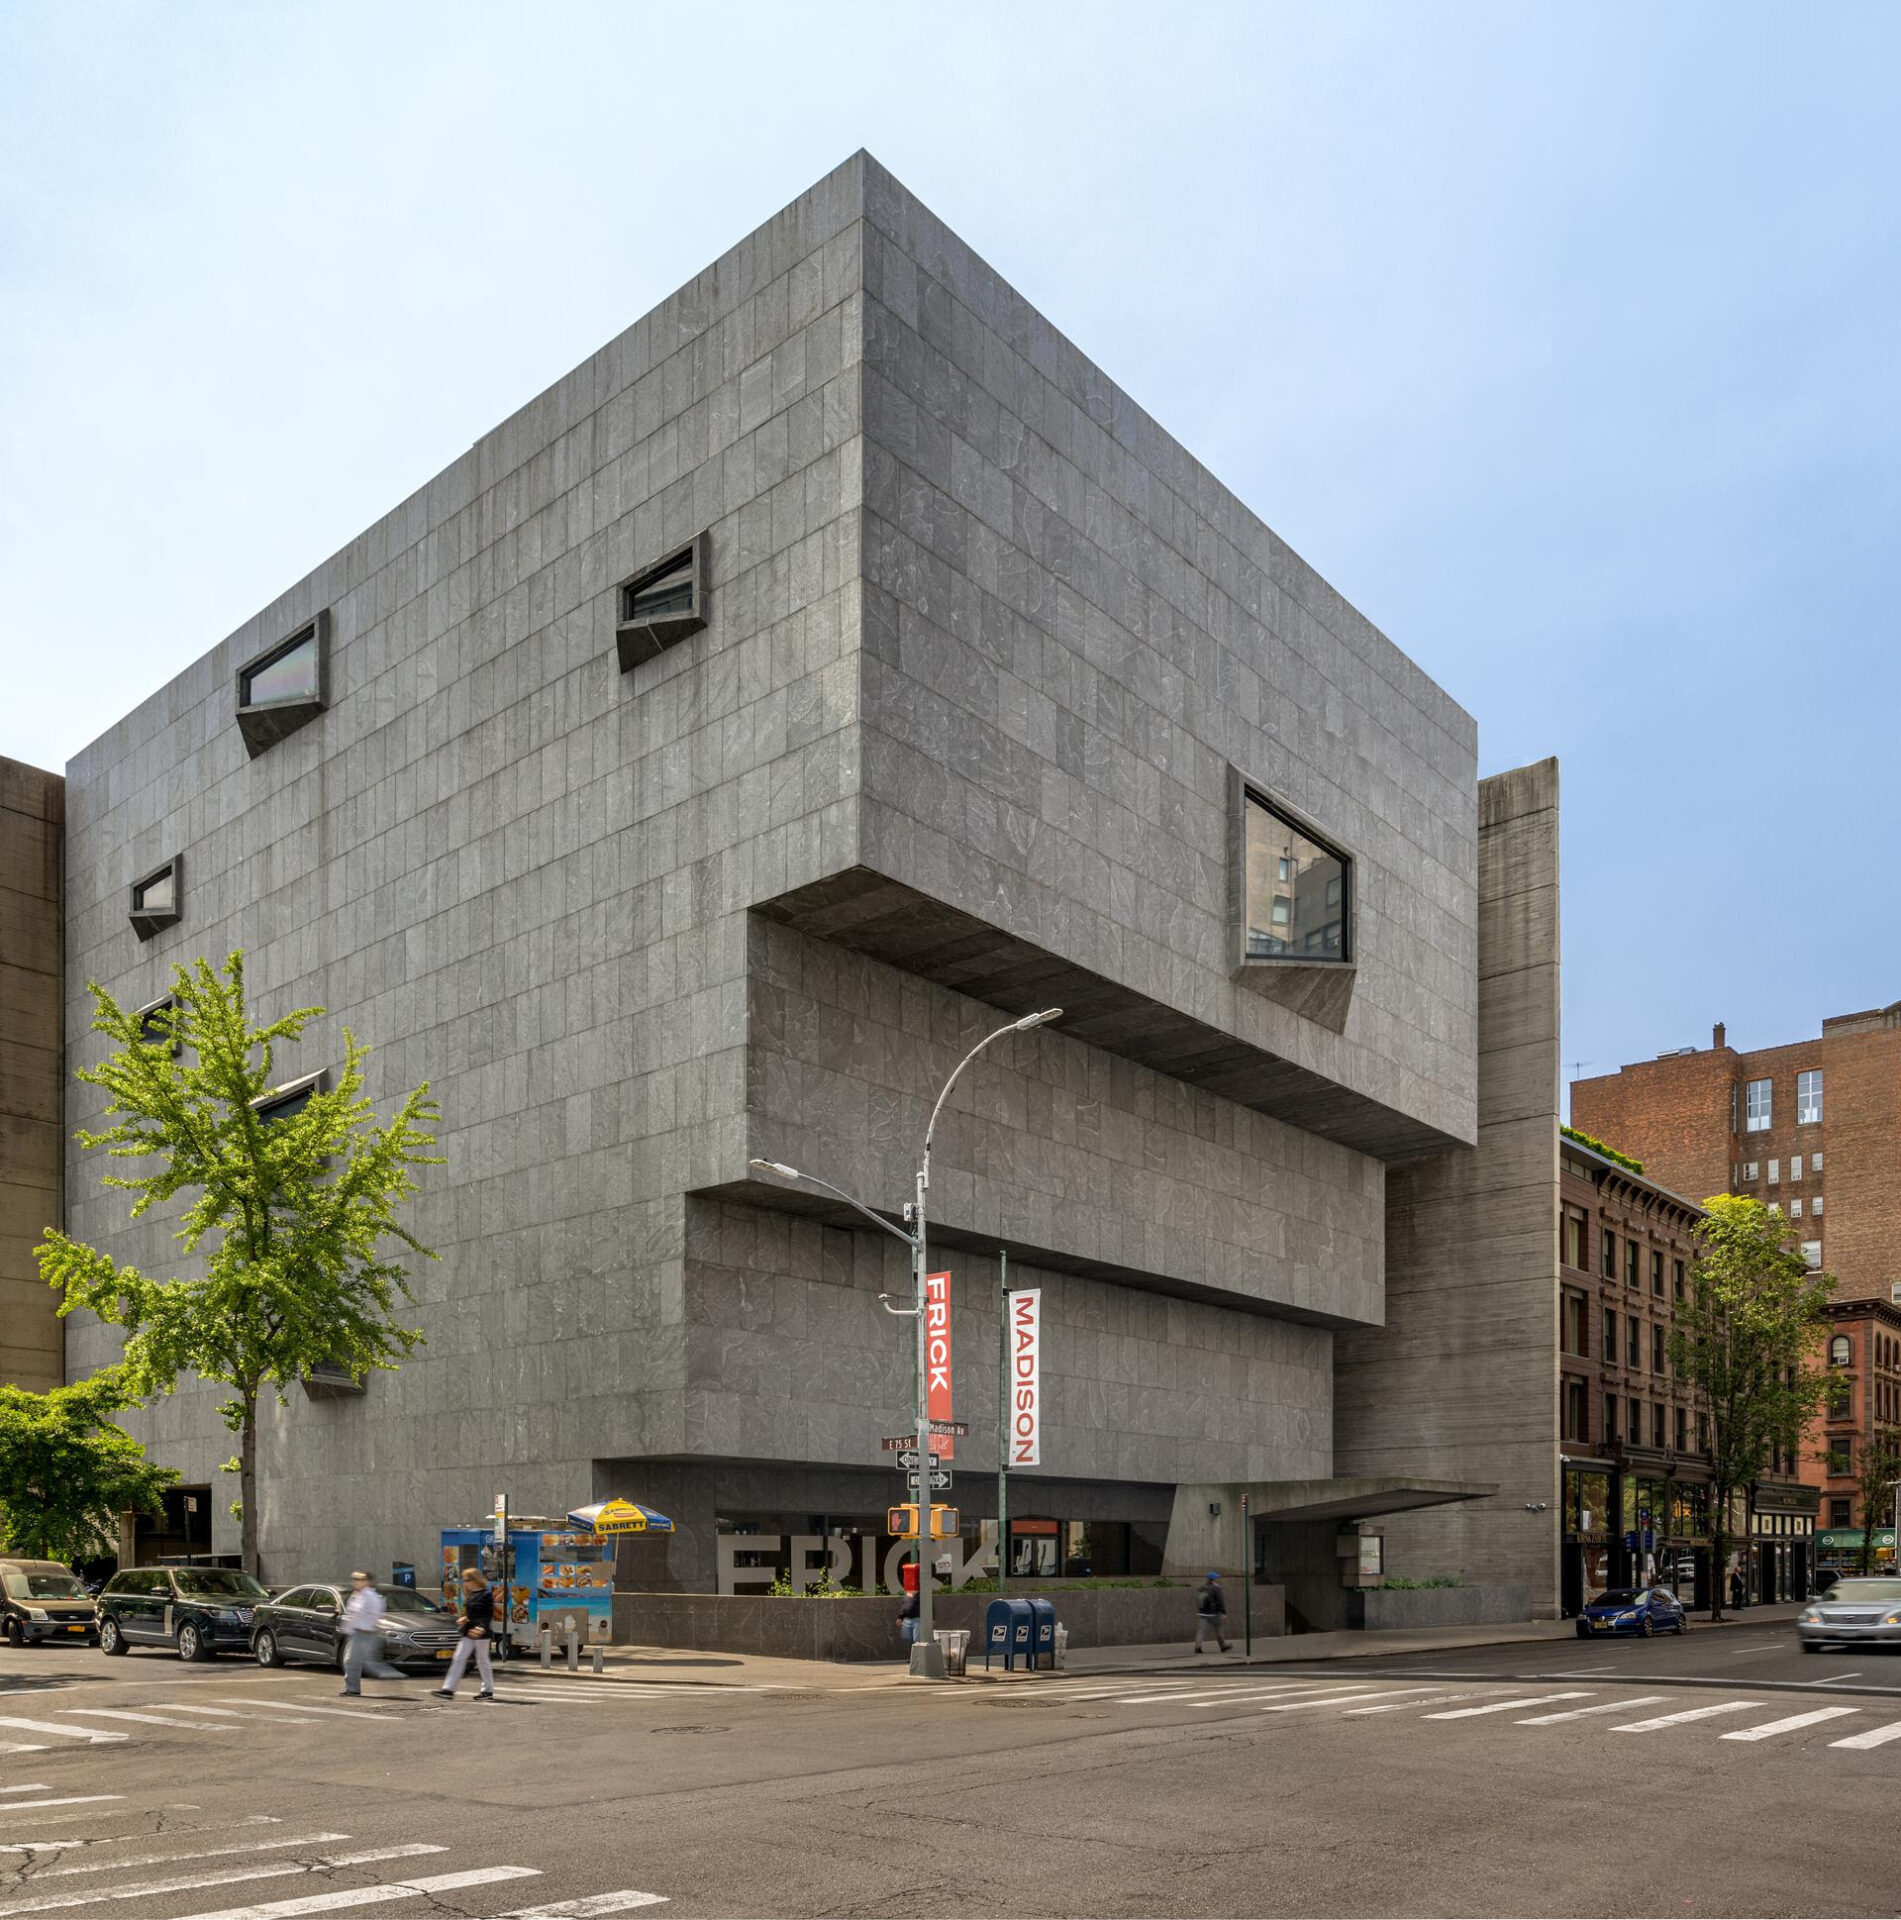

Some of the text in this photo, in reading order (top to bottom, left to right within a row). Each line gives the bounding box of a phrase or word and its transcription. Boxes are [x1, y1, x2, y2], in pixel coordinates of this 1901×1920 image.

[927, 1277, 948, 1392] FRICK
[1016, 1297, 1034, 1463] MADISON
[929, 1424, 964, 1436] Madison Av
[889, 1438, 911, 1450] E 75 St
[903, 1456, 916, 1465] ONE
[598, 1522, 644, 1532] SABRETT
[718, 1535, 999, 1595] FRICK
[404, 1573, 411, 1583] P
